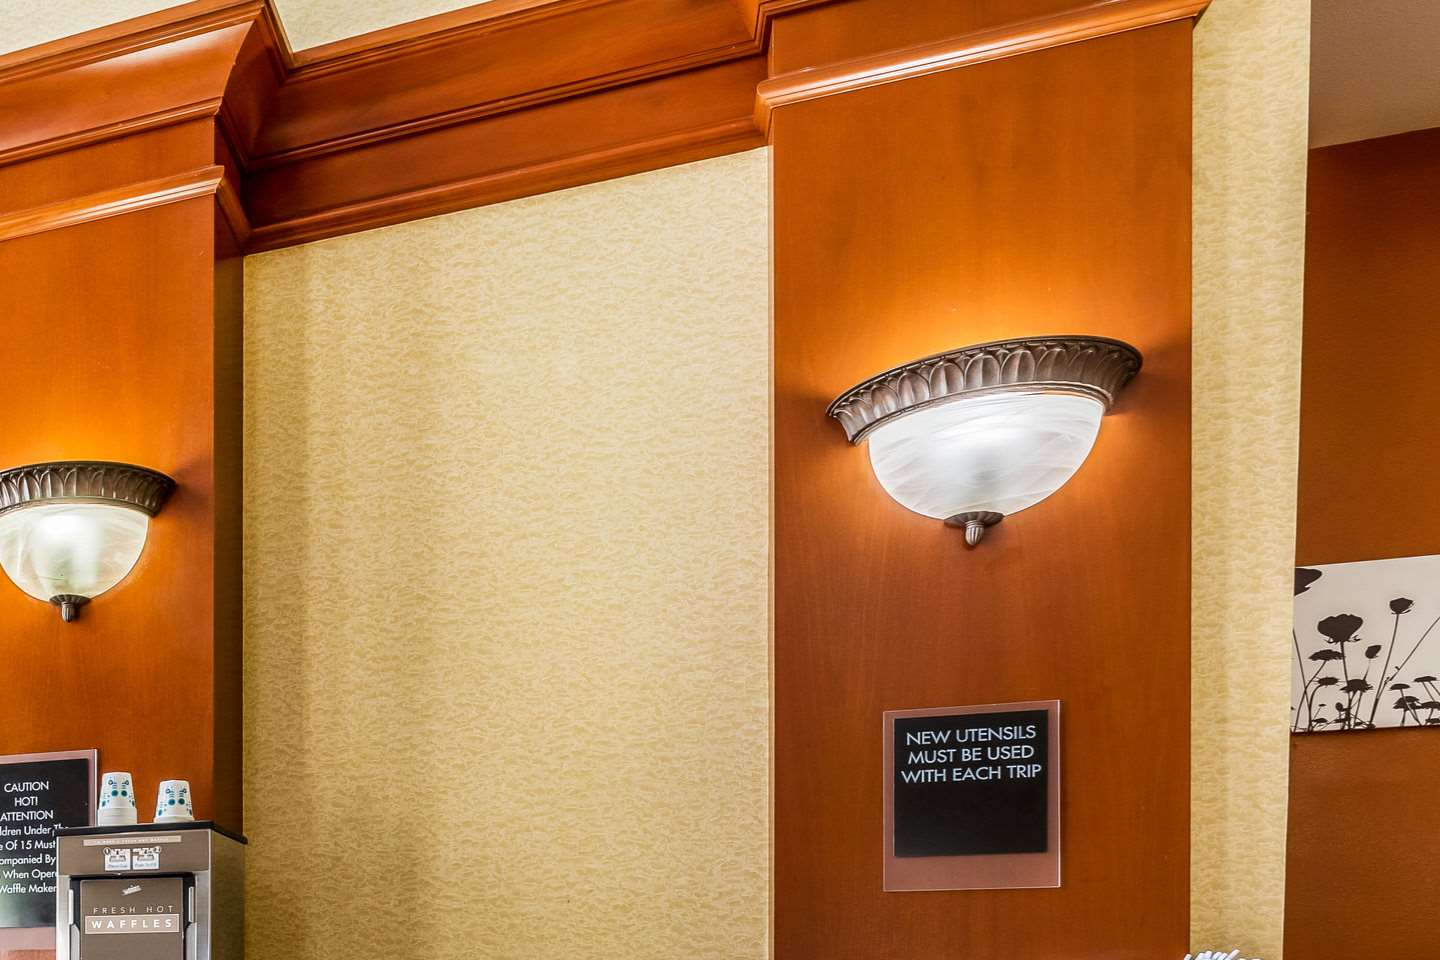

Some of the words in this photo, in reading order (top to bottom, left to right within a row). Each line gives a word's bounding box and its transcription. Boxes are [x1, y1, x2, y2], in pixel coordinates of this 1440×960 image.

[906, 730, 951, 746] NEW
[956, 725, 1037, 743] UTENSILS
[907, 749, 956, 765] MUST
[961, 748, 982, 762] BE
[987, 745, 1035, 760] USED
[901, 768, 947, 783] WITH
[952, 766, 1002, 781] EACH
[1007, 764, 1042, 779] TRIP
[4, 781, 50, 793] CAUTION
[14, 796, 39, 807] HOT!
[0, 810, 54, 822] ATTENTION
[23, 824, 51, 836] Under
[5, 840, 18, 850] Of
[21, 840, 32, 850] 15
[34, 839, 56, 850] Must
[44, 853, 57, 866] By
[2, 870, 29, 881] When
[28, 882, 58, 894] Maker
[93, 906, 136, 914] FRESH
[146, 905, 174, 913] HOT
[91, 919, 172, 929] WAFFLES
